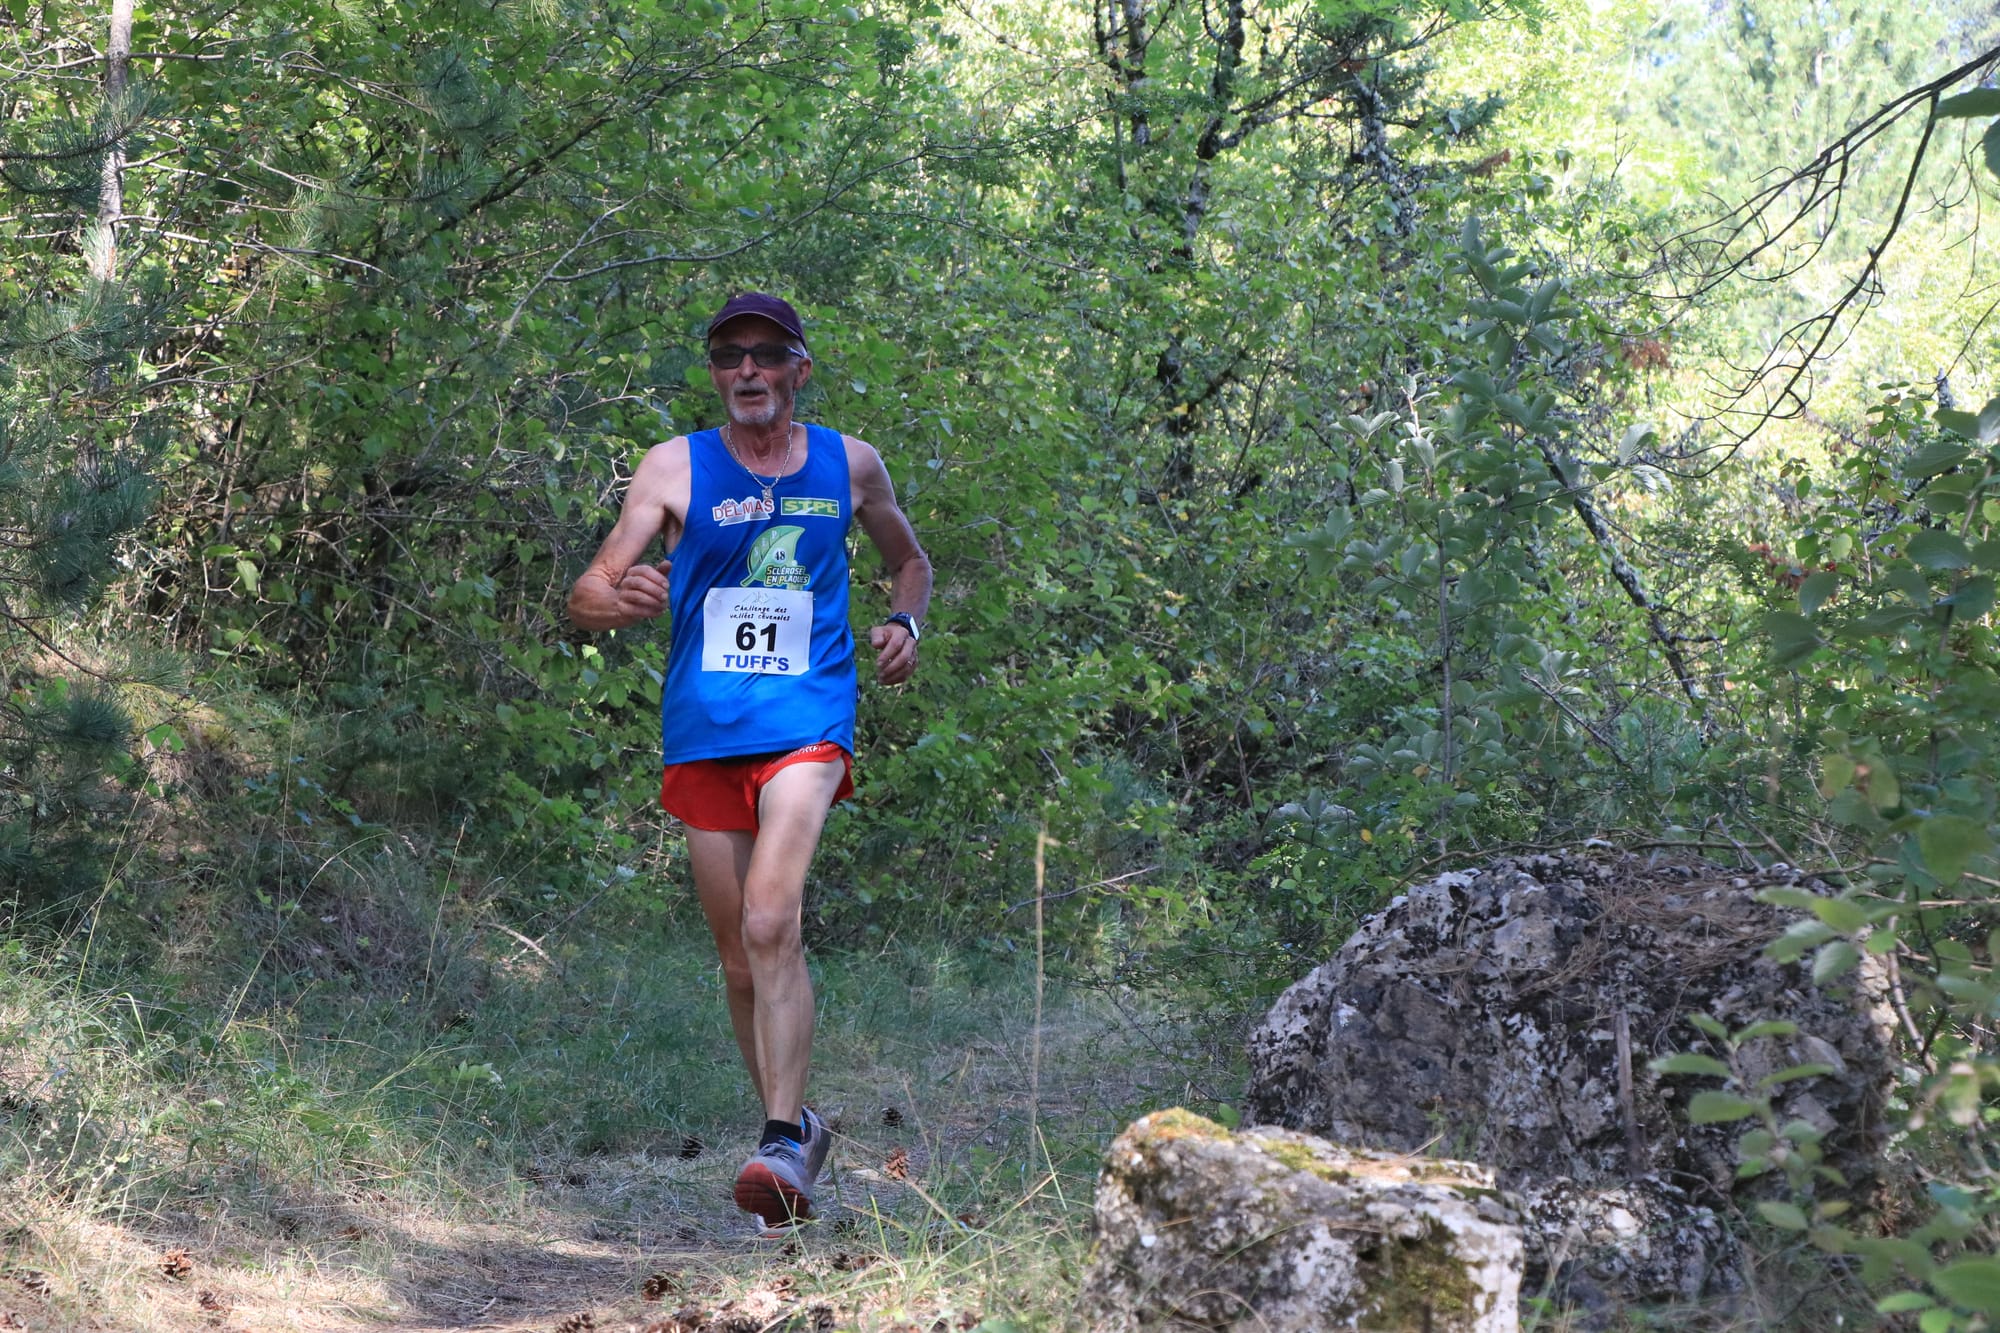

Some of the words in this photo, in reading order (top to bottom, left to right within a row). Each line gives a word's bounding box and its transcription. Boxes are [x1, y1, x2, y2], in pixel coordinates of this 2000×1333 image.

[714, 499, 774, 520] DELMAS
[774, 551, 786, 561] 48
[734, 605, 770, 614] Challenge
[736, 621, 777, 652] 61
[723, 654, 789, 671] TUFF'S
